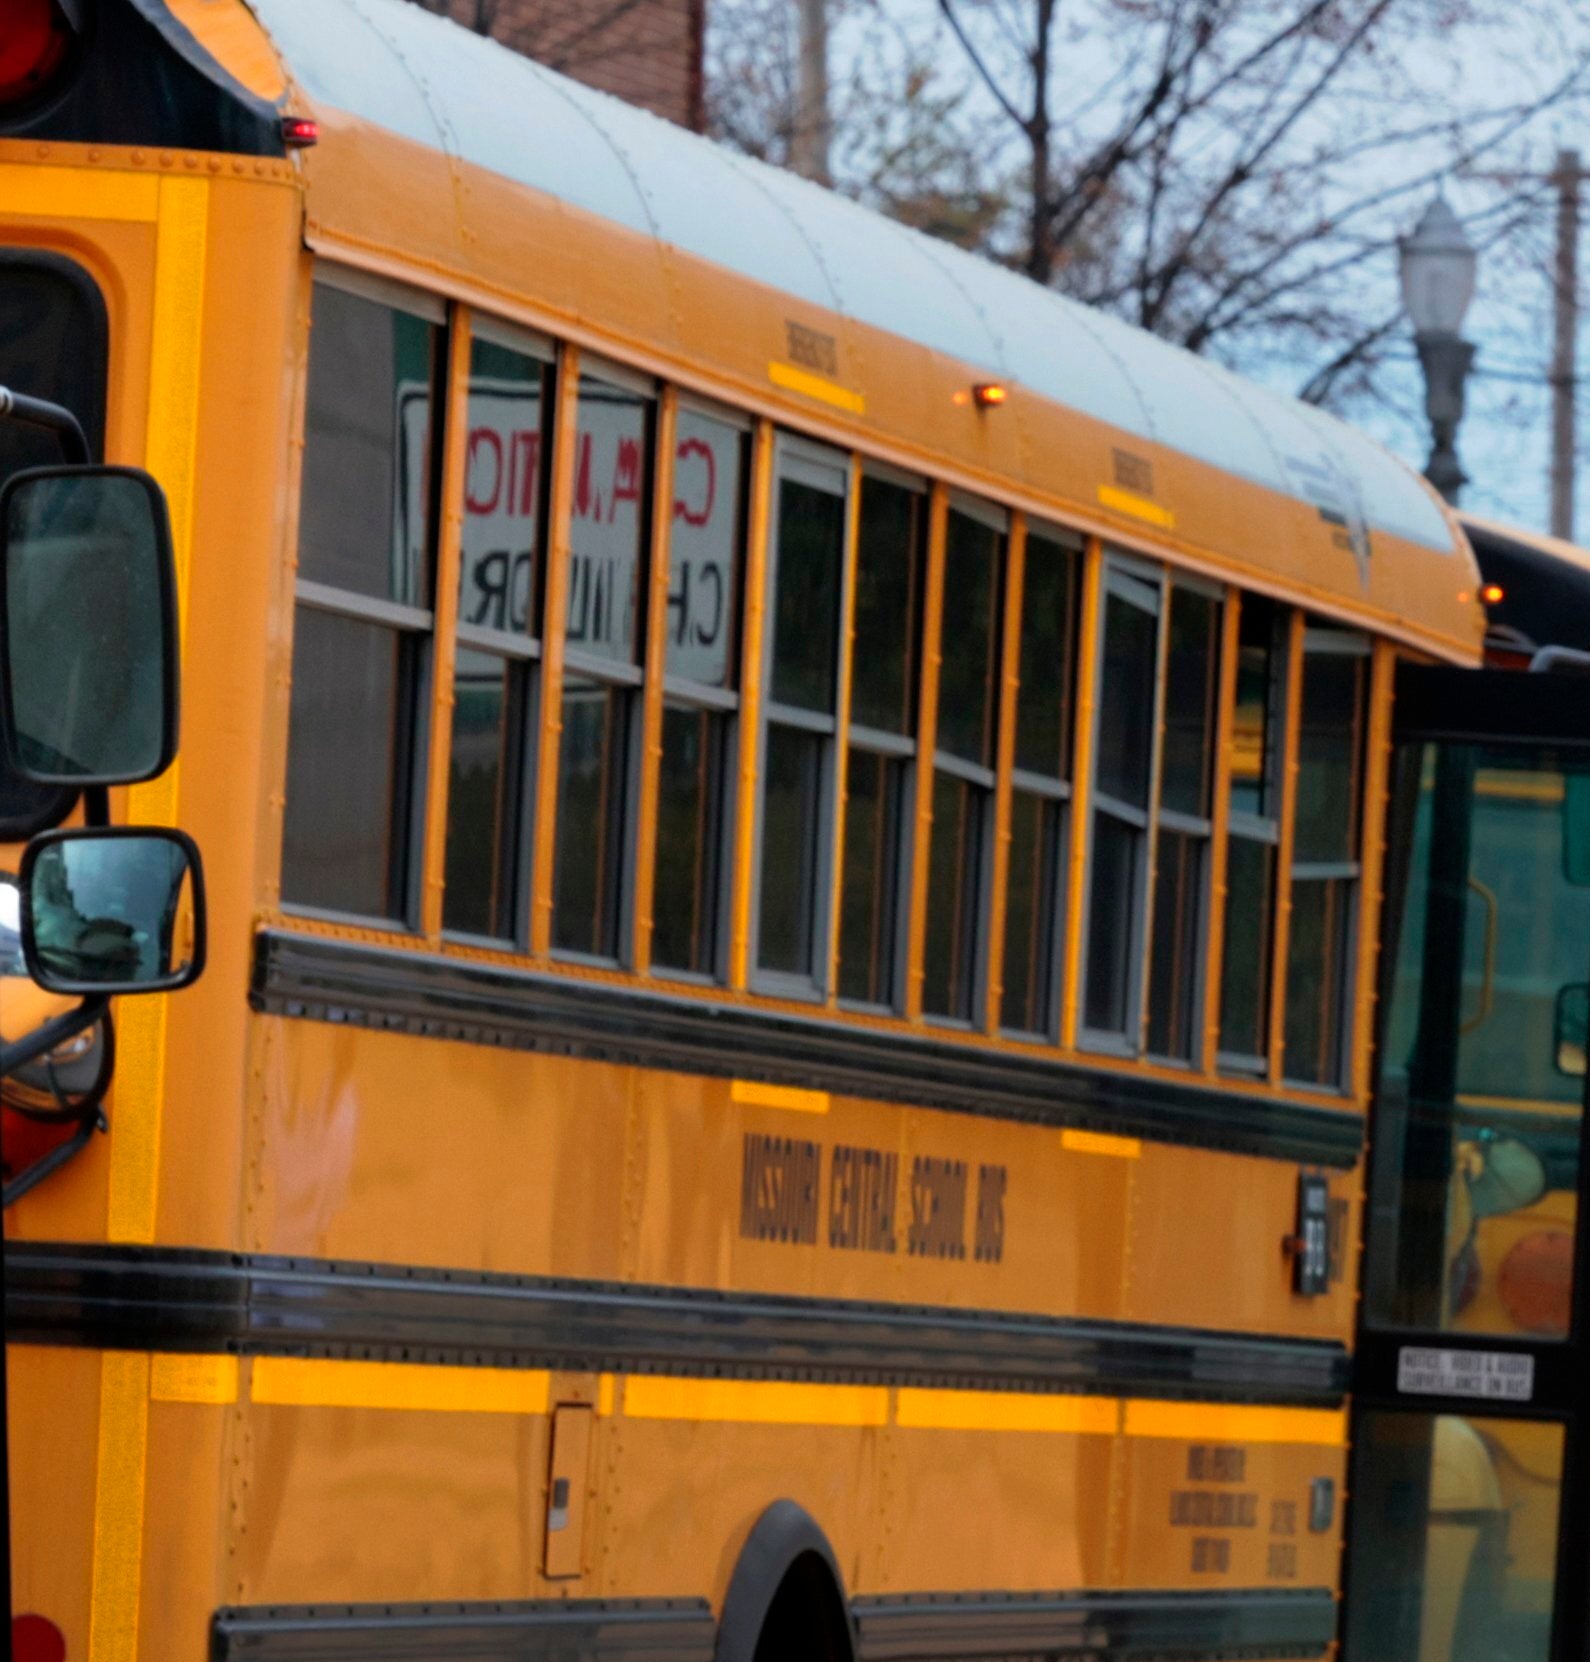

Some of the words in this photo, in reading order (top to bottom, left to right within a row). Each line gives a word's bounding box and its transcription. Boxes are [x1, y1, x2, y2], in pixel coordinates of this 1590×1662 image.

[740, 1132, 821, 1246] MISSOURI
[829, 1143, 899, 1254] CENTRAL
[974, 1164, 1007, 1263] BUS
